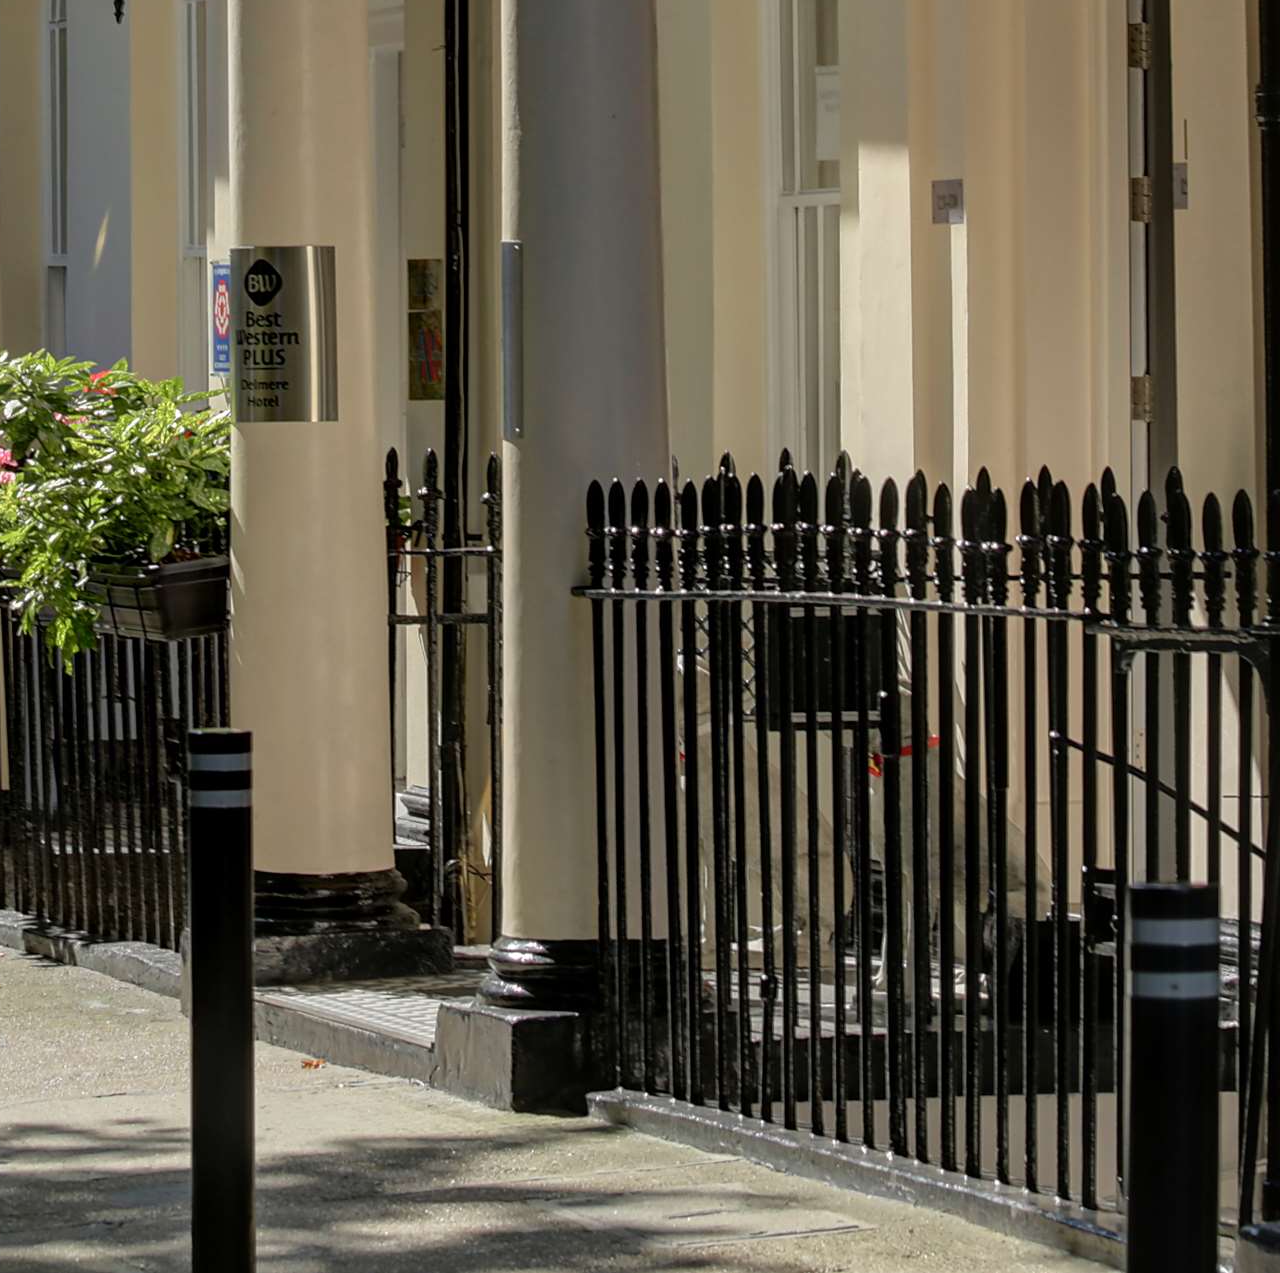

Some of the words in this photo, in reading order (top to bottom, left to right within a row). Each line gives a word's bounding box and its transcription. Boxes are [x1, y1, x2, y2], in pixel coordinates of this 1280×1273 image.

[247, 274, 277, 293] BW
[246, 311, 282, 328] Best
[243, 349, 286, 365] PLUS
[248, 395, 279, 407] Hotel
